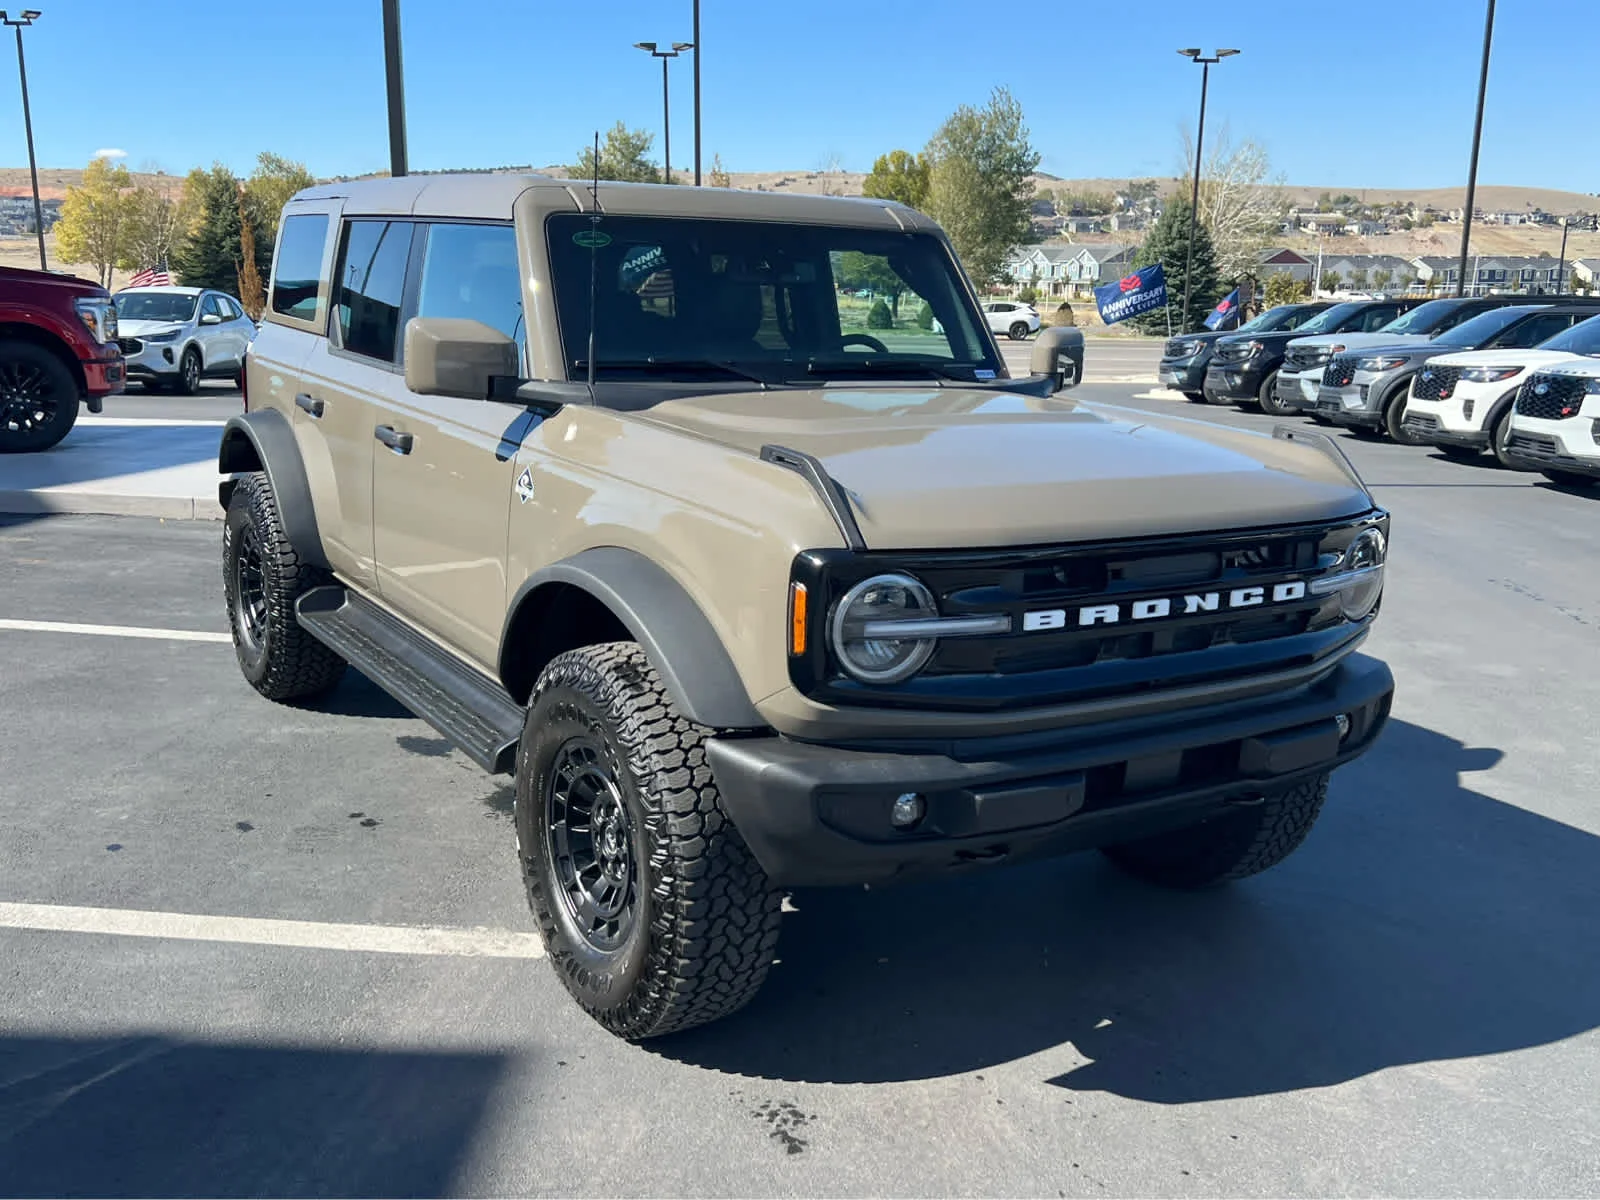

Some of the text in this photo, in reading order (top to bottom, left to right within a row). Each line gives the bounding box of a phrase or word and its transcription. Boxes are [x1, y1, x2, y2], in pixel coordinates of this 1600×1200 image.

[1102, 287, 1164, 316] ANNIVERSARY
[1110, 298, 1161, 320] SALES EVENT
[1023, 581, 1306, 631] BRONCO
